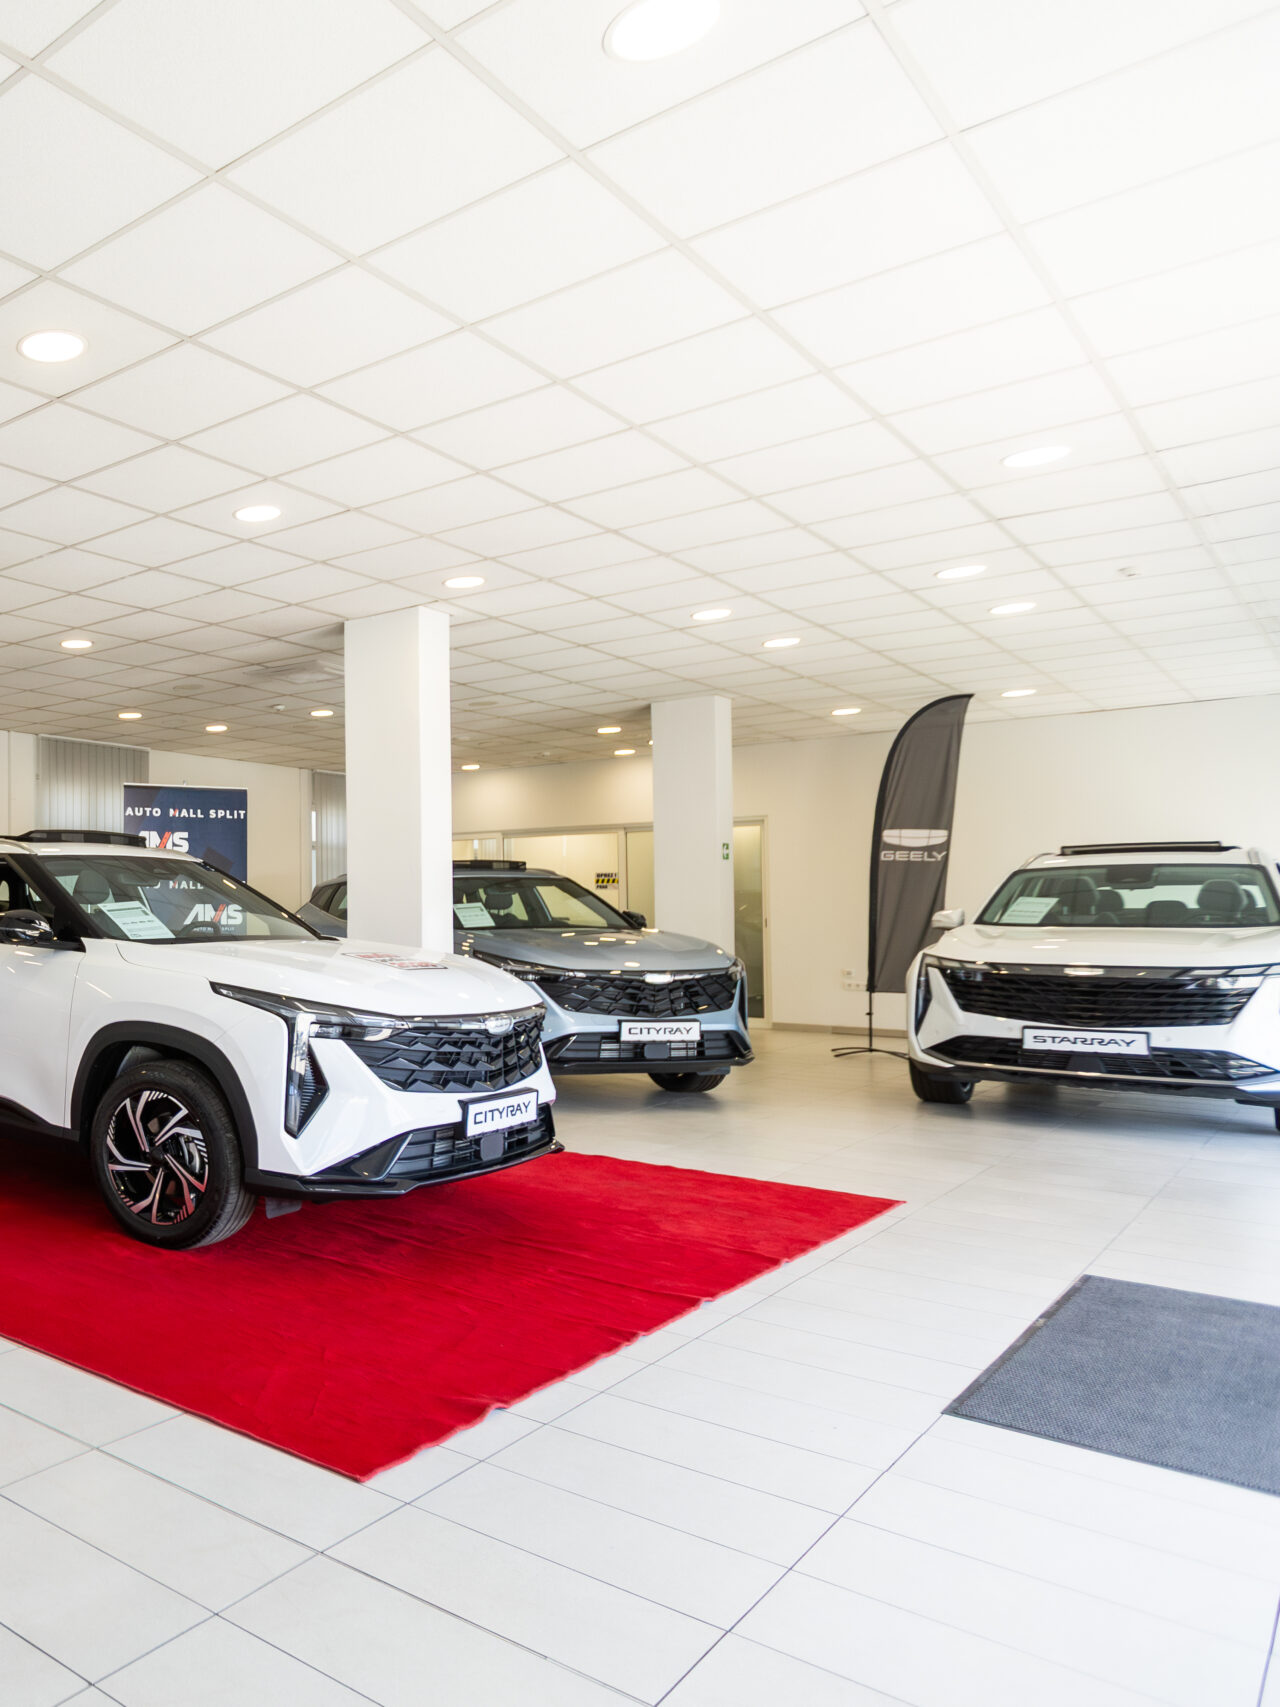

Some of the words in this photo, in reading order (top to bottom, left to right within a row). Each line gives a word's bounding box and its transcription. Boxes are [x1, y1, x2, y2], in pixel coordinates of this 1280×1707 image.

[125, 807, 161, 816] AUTO
[169, 808, 204, 818] MALL
[209, 809, 246, 819] SPLIT
[880, 850, 948, 861] GEELY
[183, 904, 243, 925] AMS
[628, 1027, 693, 1035] CITYRAY
[1032, 1035, 1136, 1047] STARRAY
[473, 1100, 531, 1125] CITYRAY
